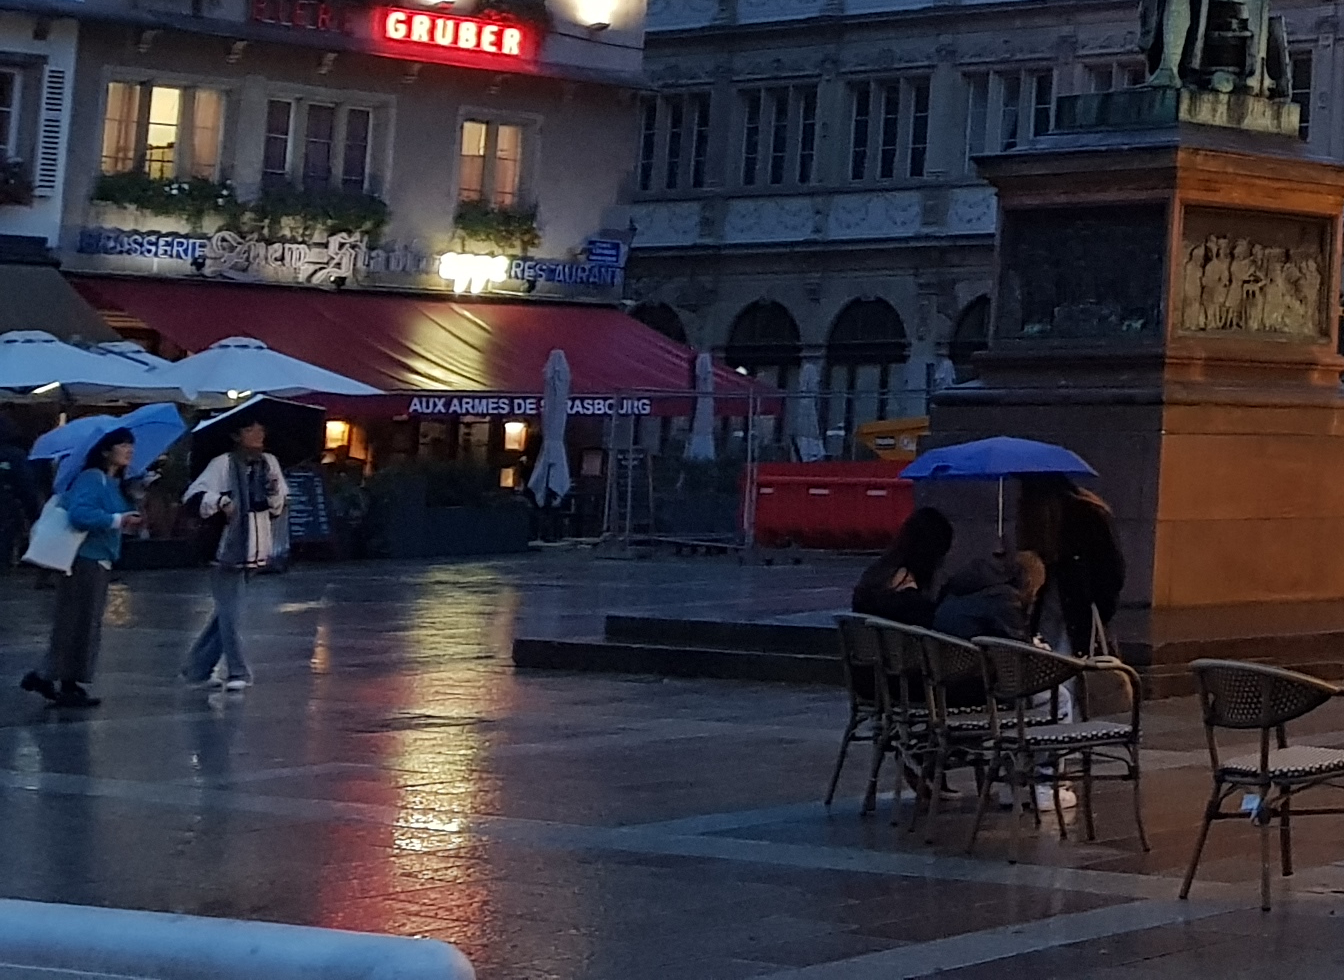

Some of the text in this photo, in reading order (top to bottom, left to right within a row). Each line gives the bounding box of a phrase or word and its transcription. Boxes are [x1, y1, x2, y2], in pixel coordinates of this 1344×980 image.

[385, 11, 521, 55] GRUBER
[409, 397, 446, 414] AUX
[449, 398, 510, 415] ARMES
[514, 398, 538, 415] DE
